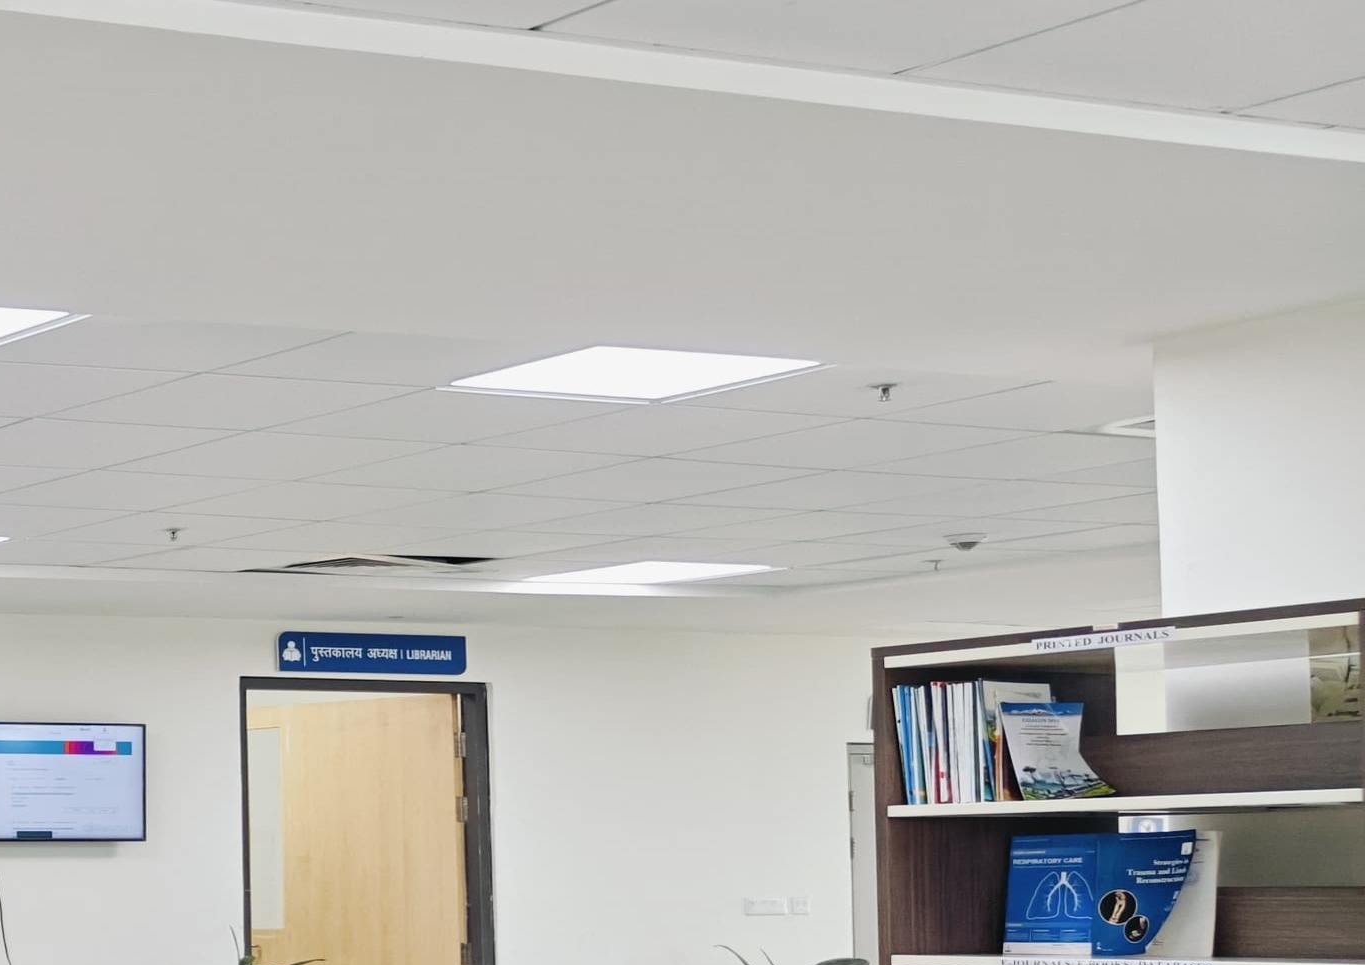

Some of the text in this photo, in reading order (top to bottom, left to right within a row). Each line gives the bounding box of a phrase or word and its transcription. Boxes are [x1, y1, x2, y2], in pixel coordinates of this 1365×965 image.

[1035, 629, 1170, 651] PRINTED JOURNALS
[310, 645, 398, 662] पुस्तकालय अध्यक्ष
[406, 649, 452, 661] LIBRARIAN
[1063, 856, 1083, 864] CARE
[1126, 868, 1156, 877] Trauma
